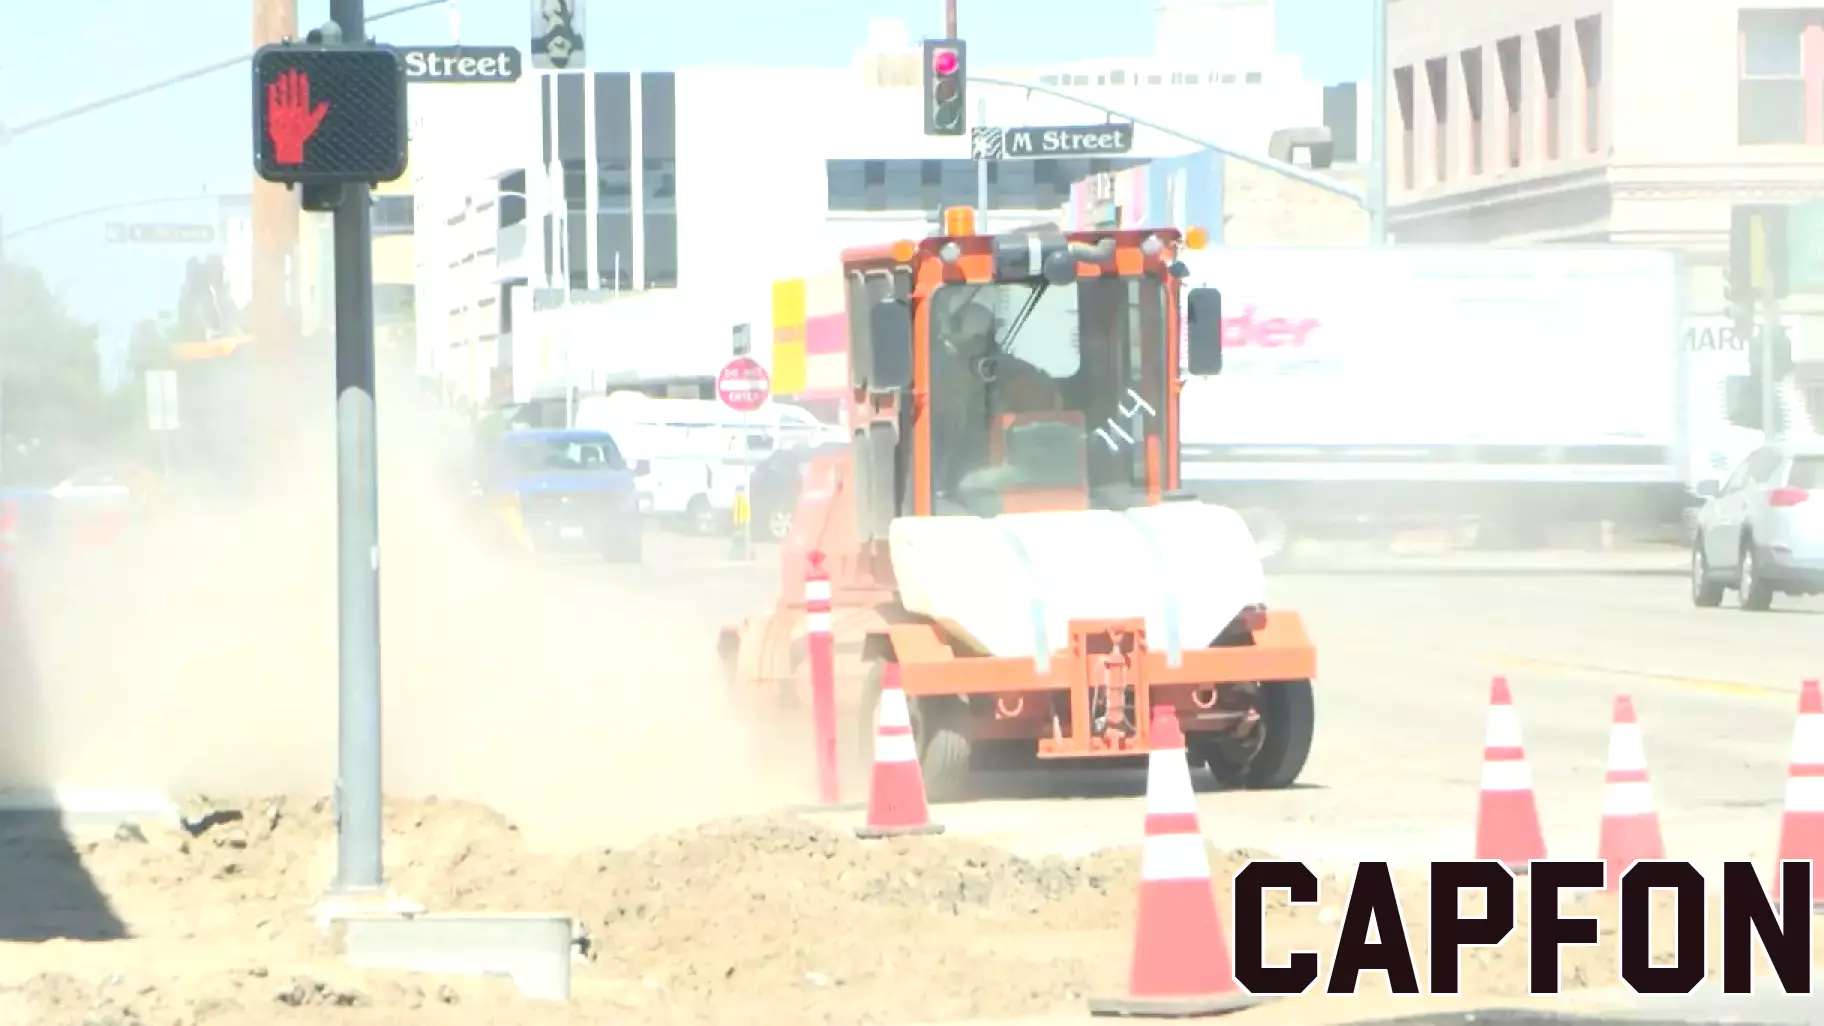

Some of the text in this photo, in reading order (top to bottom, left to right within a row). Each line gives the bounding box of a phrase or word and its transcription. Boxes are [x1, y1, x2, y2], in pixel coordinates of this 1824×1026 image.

[404, 50, 513, 77] Street
[1012, 129, 1125, 153] M Street
[1093, 387, 1157, 452] 114
